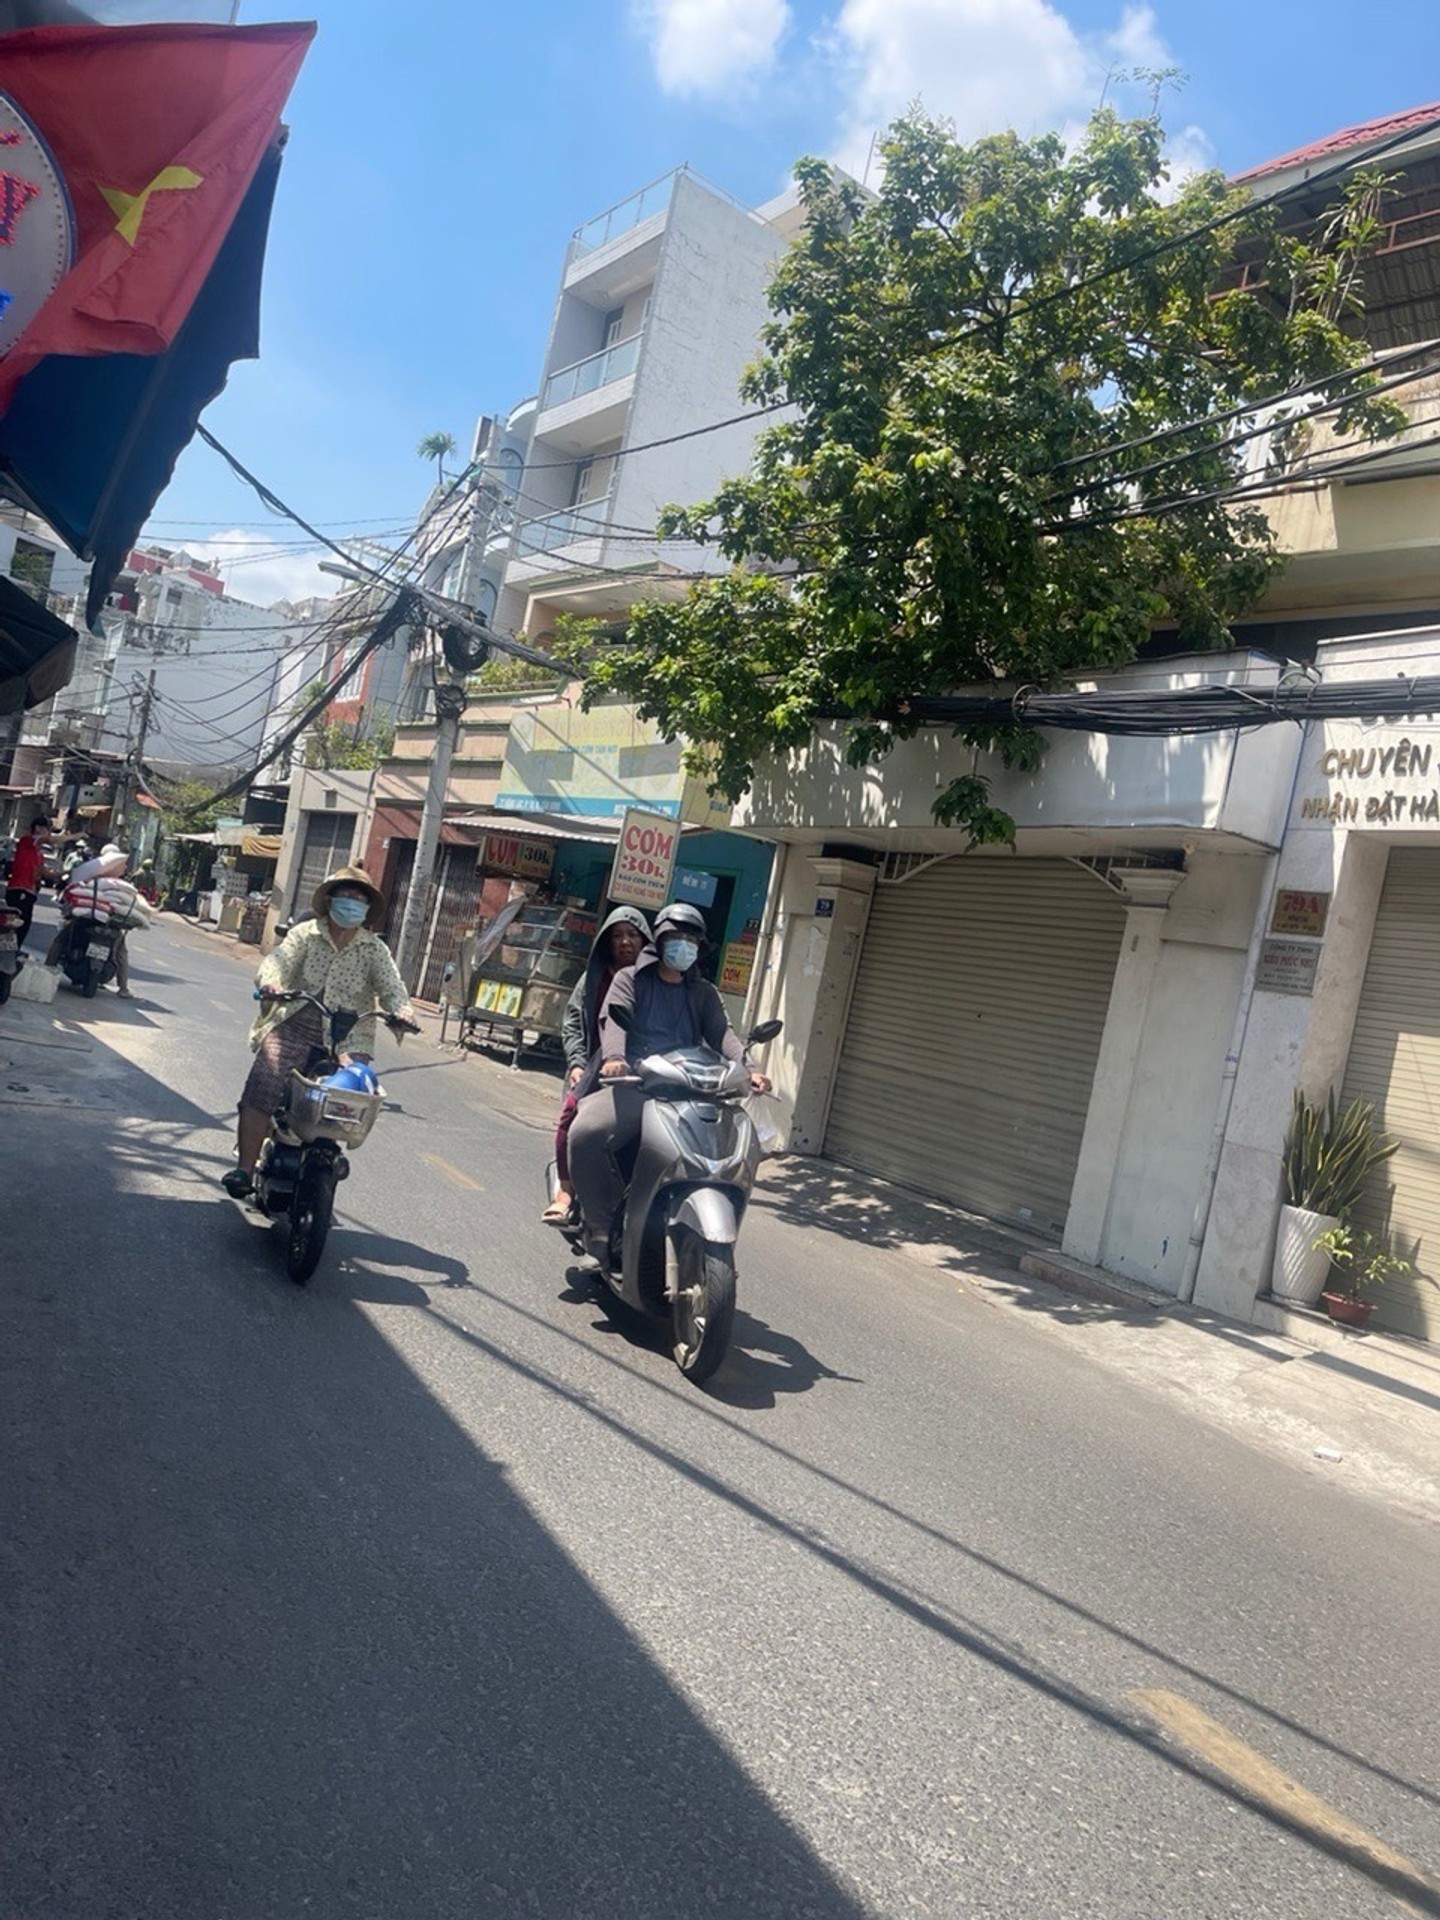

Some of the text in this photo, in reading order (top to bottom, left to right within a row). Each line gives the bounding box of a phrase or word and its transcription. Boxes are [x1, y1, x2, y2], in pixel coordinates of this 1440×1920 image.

[1321, 738, 1432, 778] CHUYÊN
[1301, 791, 1358, 824] NHẬN
[1365, 790, 1407, 826] ĐẶT
[625, 825, 674, 861] CƠM
